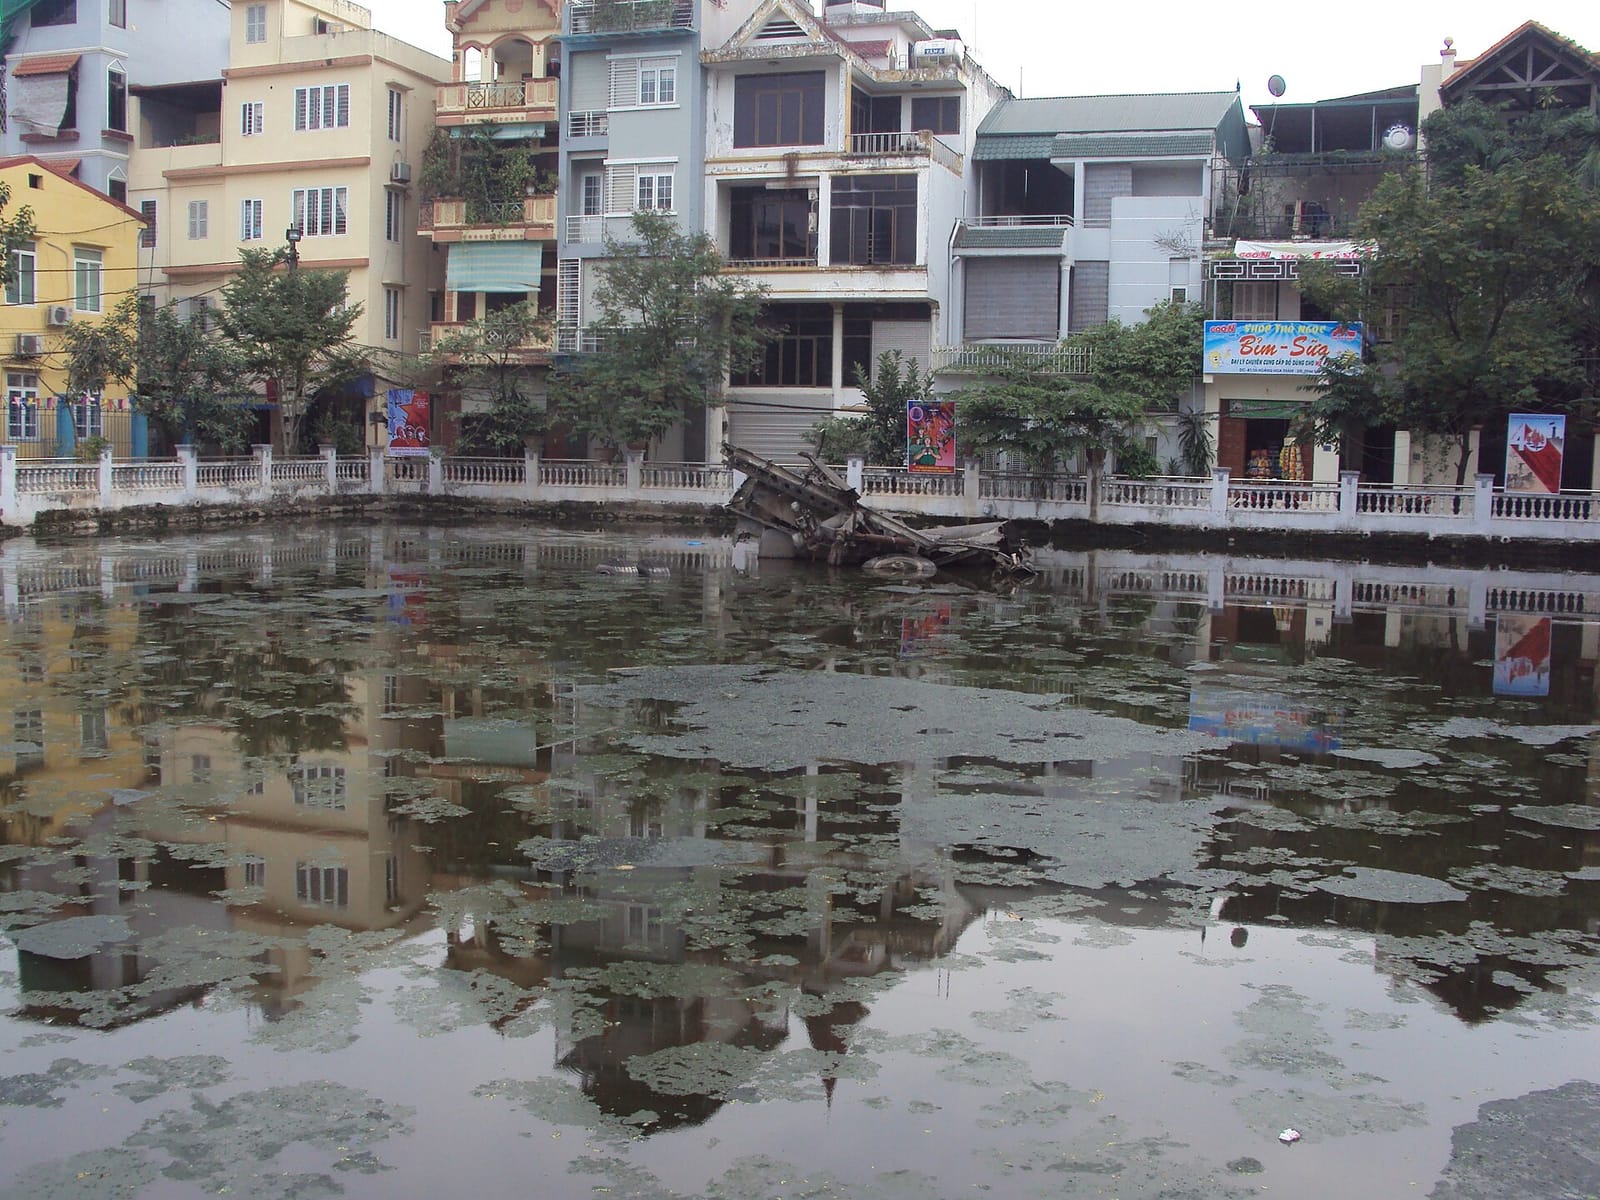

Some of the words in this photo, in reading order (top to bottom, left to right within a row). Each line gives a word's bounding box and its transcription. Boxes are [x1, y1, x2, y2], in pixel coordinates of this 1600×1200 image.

[1244, 324, 1272, 334] SHOP
[1239, 334, 1278, 356] Bỉm
[1290, 336, 1330, 357] Sữa
